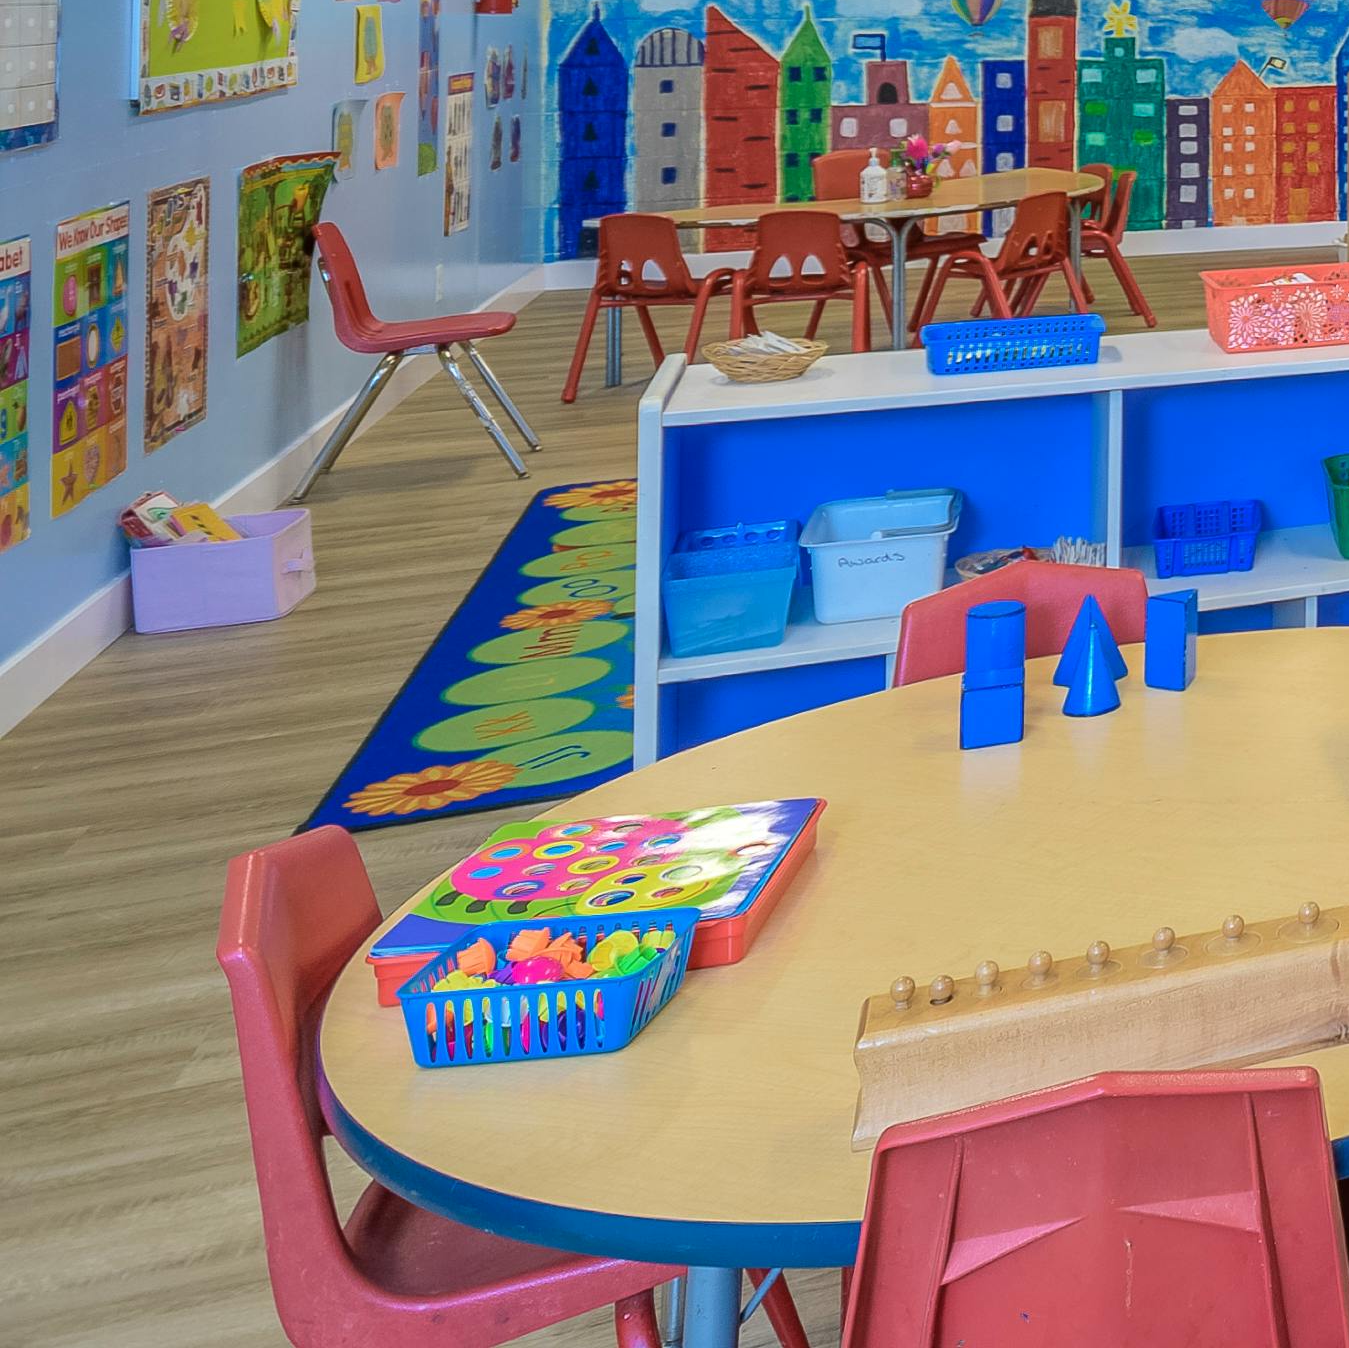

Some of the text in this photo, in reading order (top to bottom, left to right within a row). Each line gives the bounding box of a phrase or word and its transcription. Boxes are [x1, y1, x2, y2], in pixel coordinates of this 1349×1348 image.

[58, 230, 73, 251] We
[89, 219, 104, 239] Our
[837, 552, 906, 568] Awards
